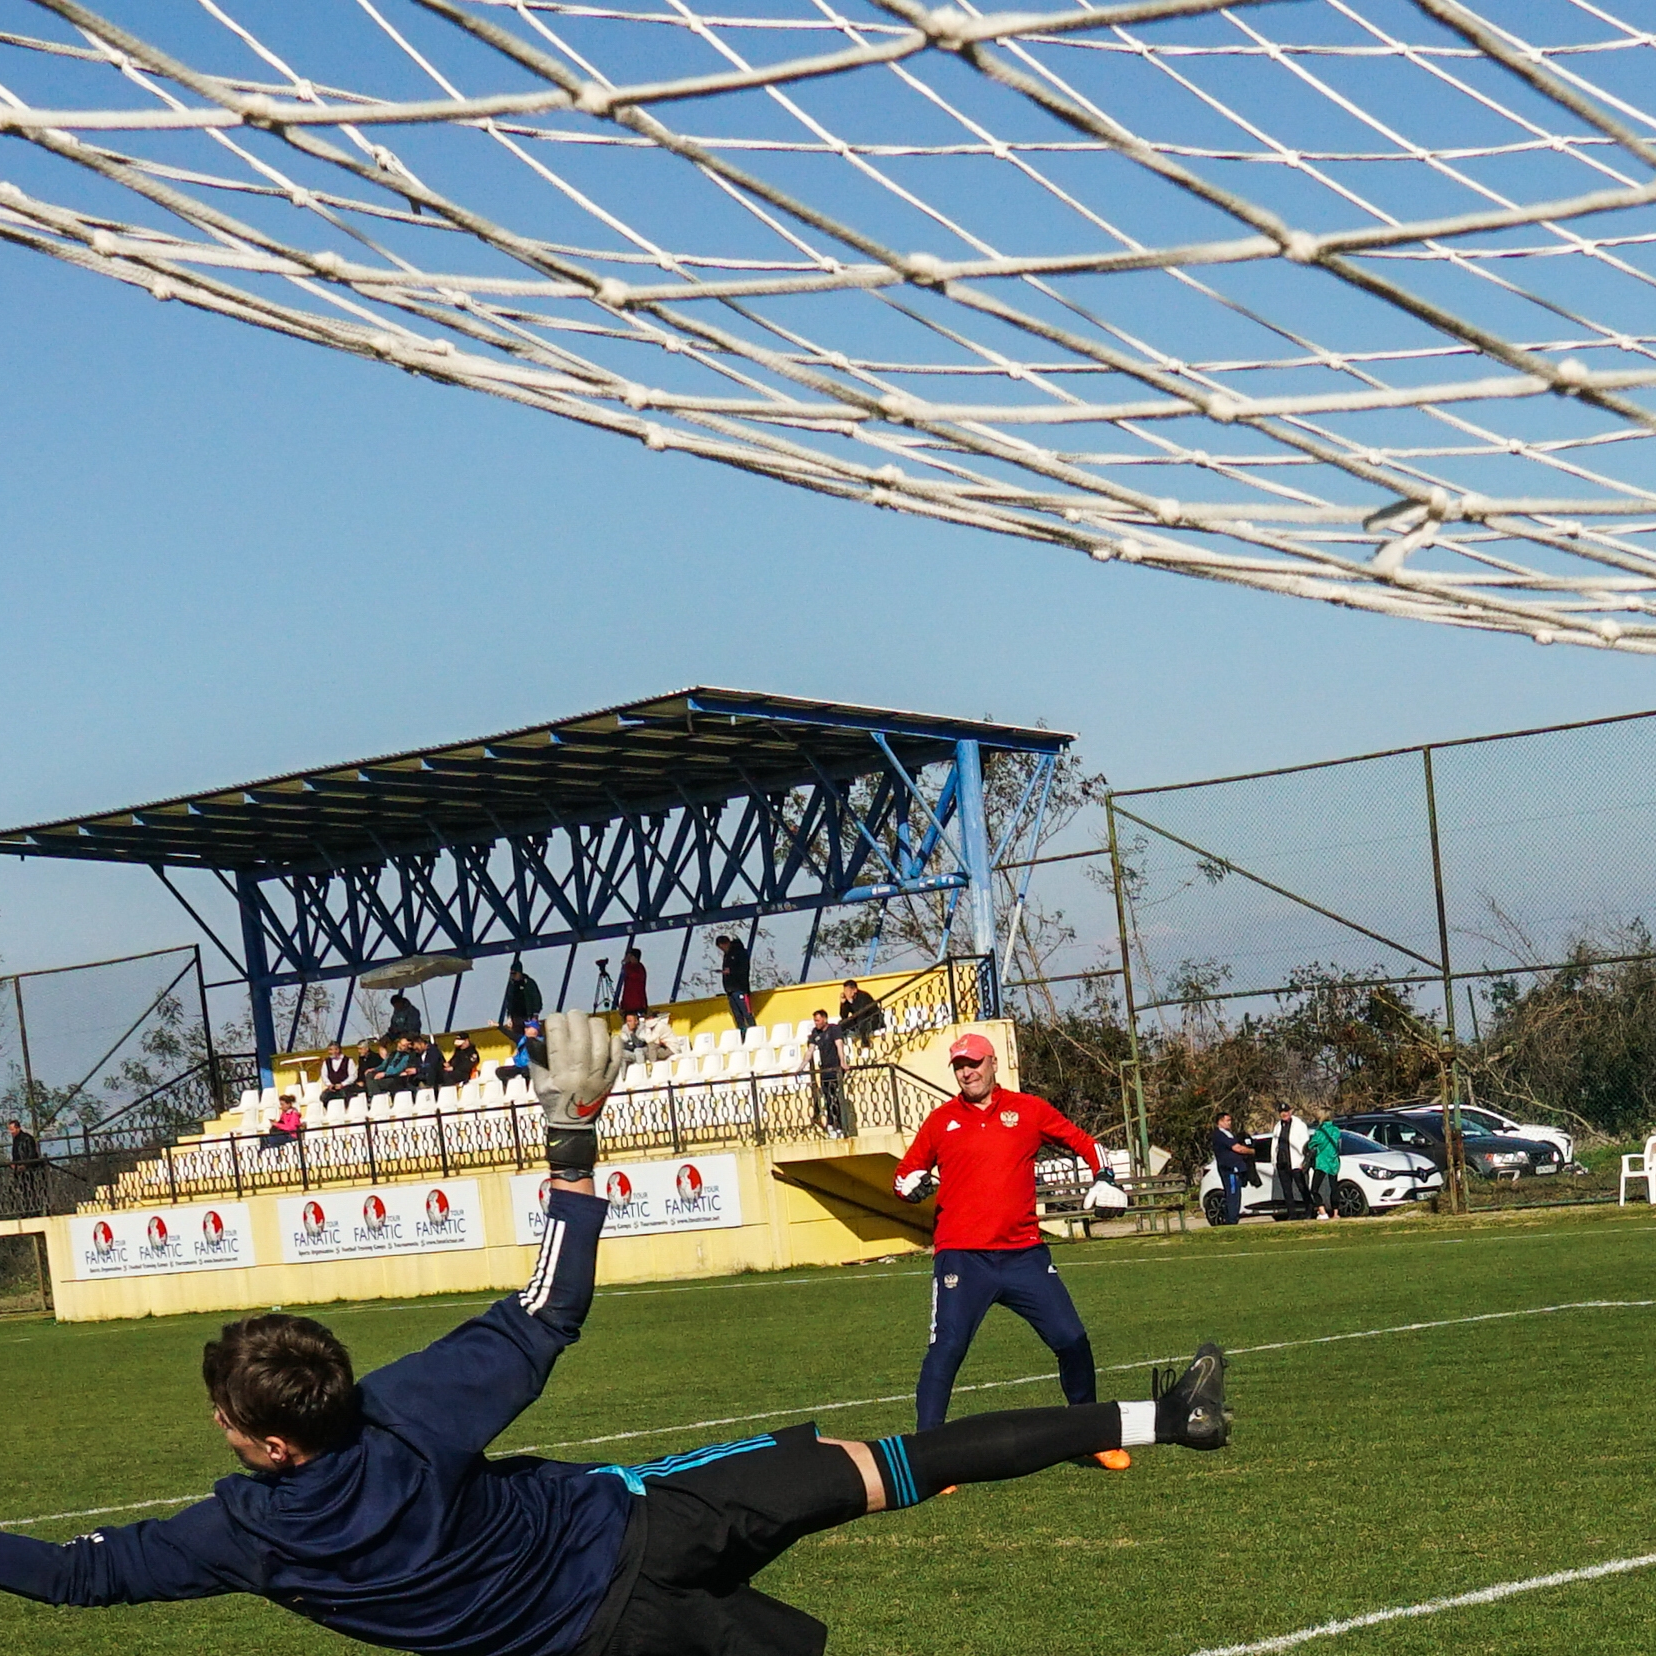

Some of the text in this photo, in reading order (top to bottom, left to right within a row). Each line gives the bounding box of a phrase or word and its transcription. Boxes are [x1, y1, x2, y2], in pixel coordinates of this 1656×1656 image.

[632, 1191, 649, 1200] TOUR
[704, 1185, 720, 1194] TOUR
[450, 1209, 465, 1218] TOUR
[605, 1201, 651, 1221] NATIC
[665, 1194, 722, 1215] FANATIC
[387, 1214, 401, 1223] TOUR
[416, 1217, 467, 1238] FANATIC
[294, 1228, 342, 1248] FANATIC
[353, 1223, 403, 1243] FANATIC
[139, 1242, 183, 1261] FANATIC
[194, 1237, 240, 1256] FANATIC
[85, 1247, 128, 1266] FANATIC
